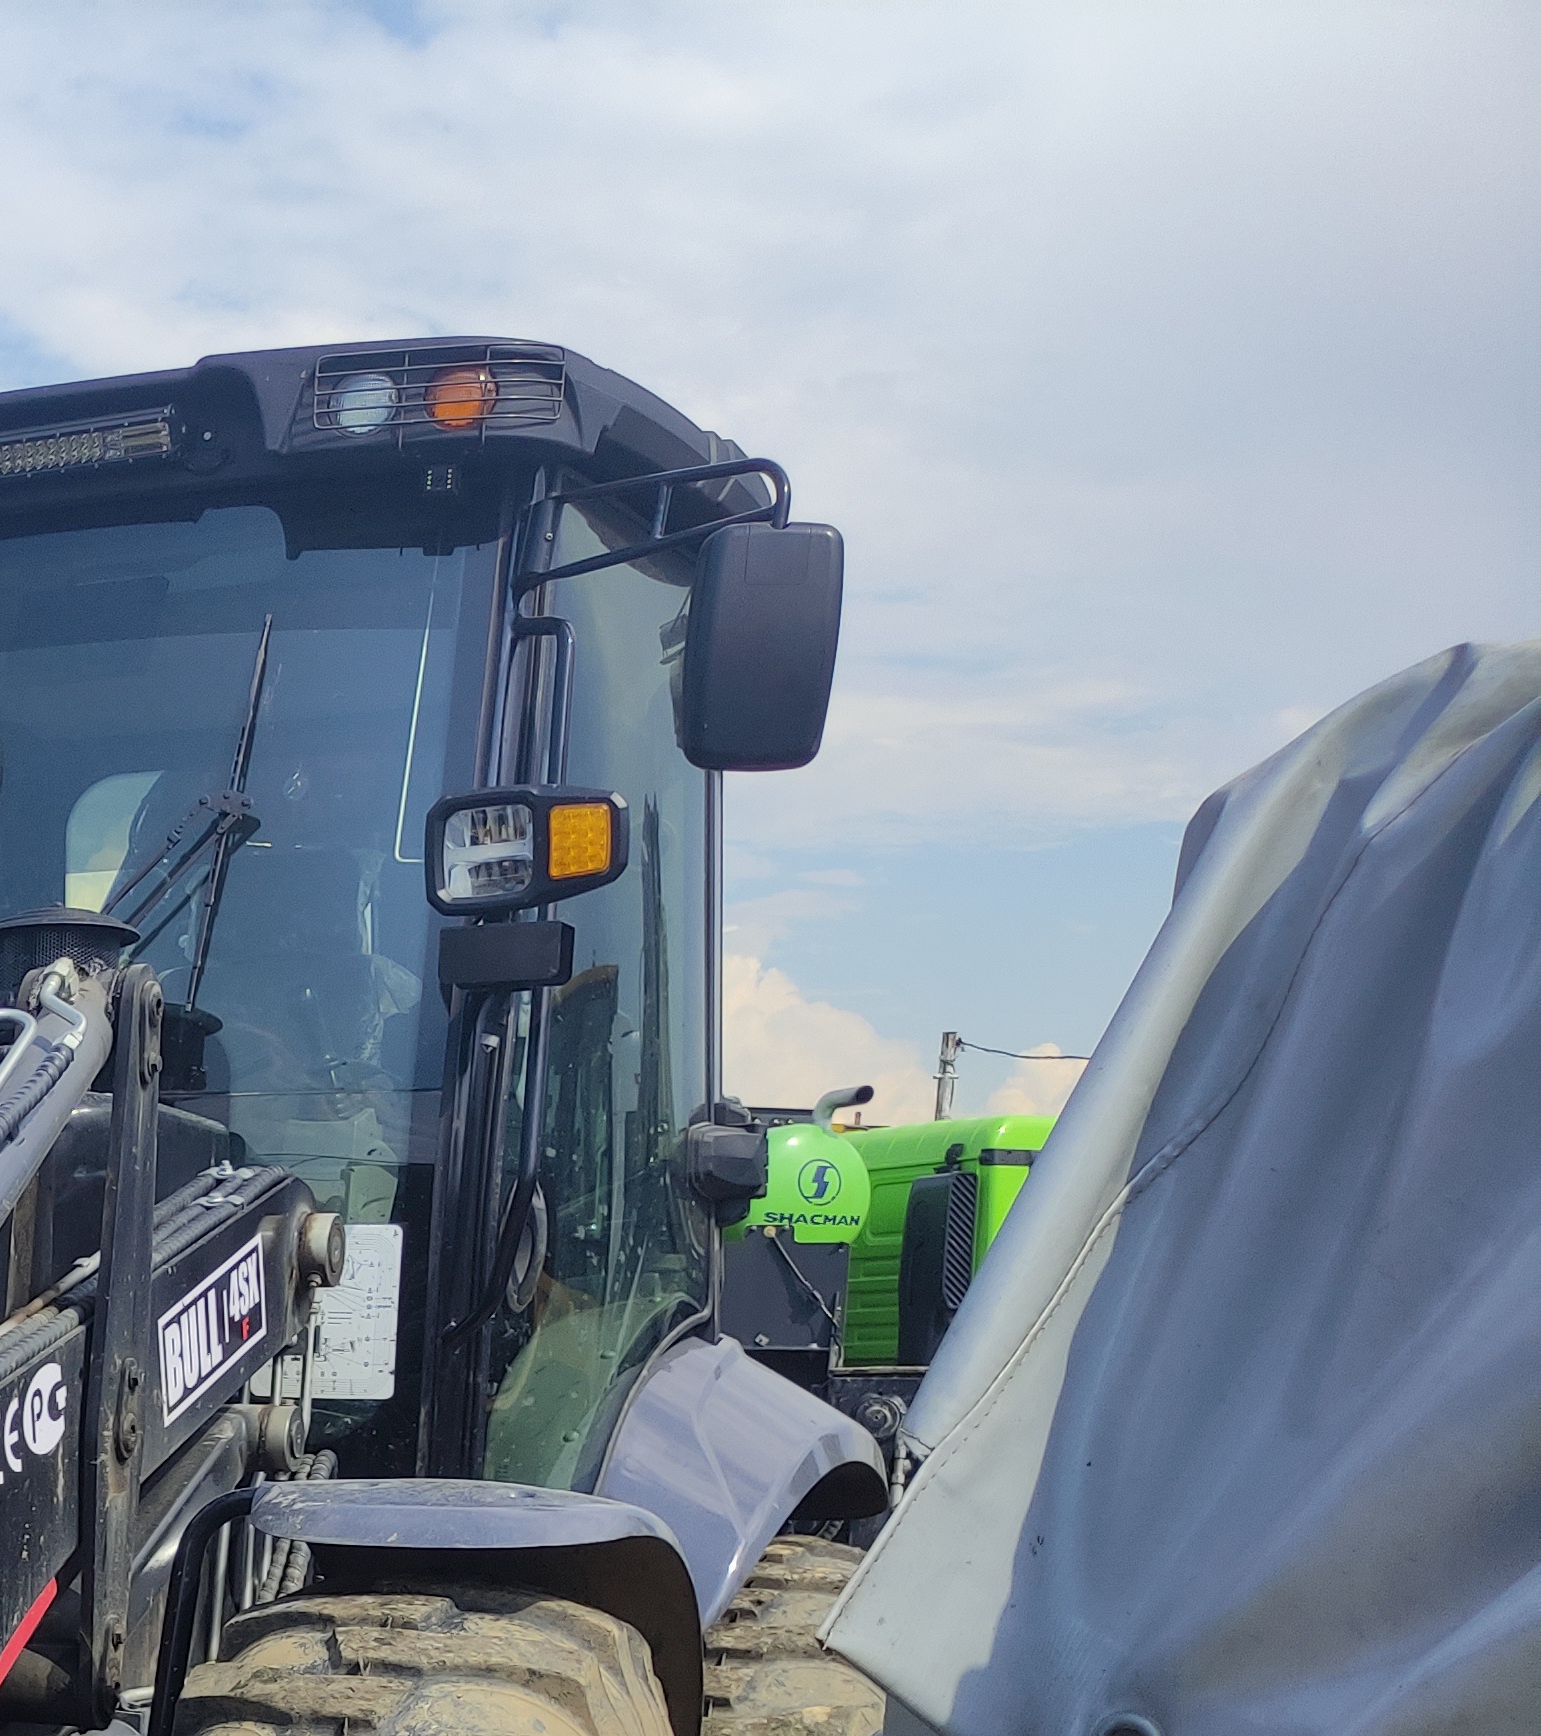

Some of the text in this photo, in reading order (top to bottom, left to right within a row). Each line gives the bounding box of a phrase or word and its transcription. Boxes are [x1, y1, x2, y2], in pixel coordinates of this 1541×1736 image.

[763, 1212, 861, 1226] SHACMAN
[163, 1250, 260, 1408] BULL 4SX
